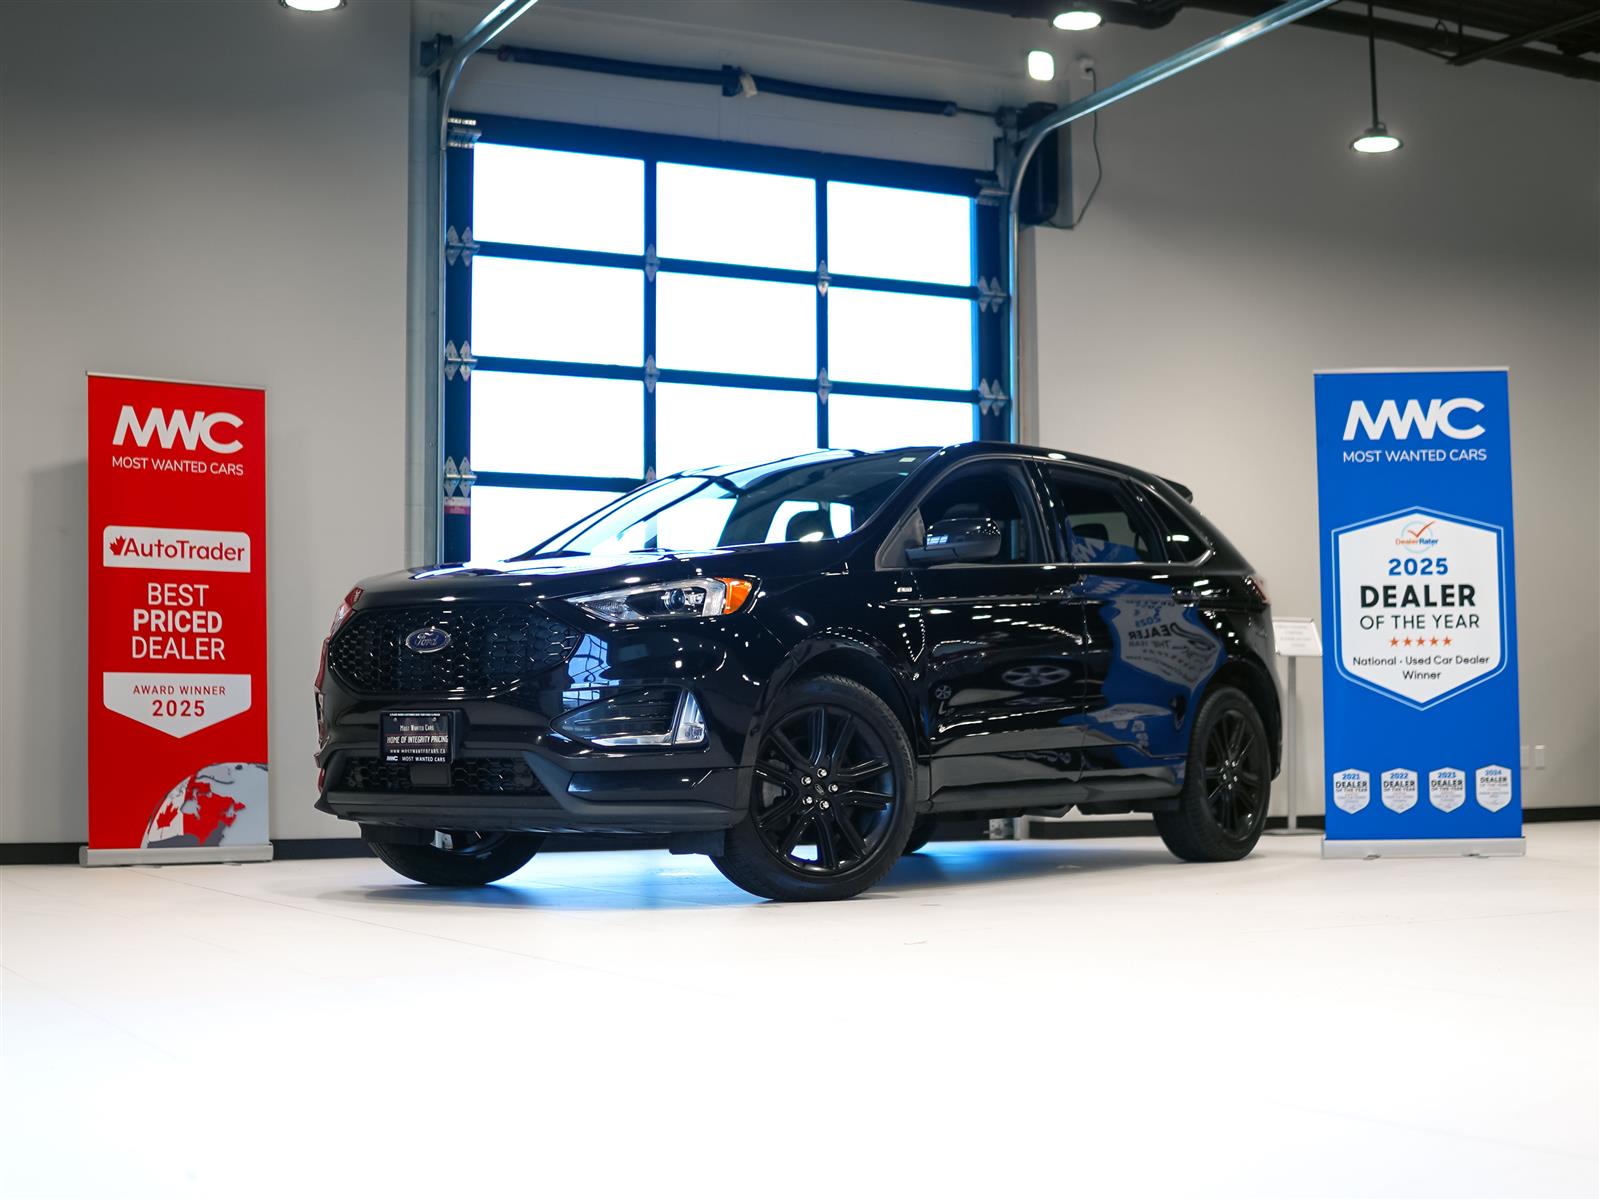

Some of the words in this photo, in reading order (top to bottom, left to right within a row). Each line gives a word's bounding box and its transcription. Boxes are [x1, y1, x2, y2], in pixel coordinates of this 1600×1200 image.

[1342, 397, 1486, 441] MWC
[112, 404, 244, 454] MWC
[1343, 450, 1382, 463] MOST
[1385, 449, 1447, 462] WANTED
[1449, 449, 1488, 461] CARS
[112, 455, 149, 470] MOST
[151, 458, 207, 474] WANTED
[210, 462, 244, 476] CARS
[123, 537, 245, 561] AutoTrader
[1388, 557, 1449, 576] 2025
[147, 582, 210, 607] BEST
[1360, 583, 1477, 609] DEALER
[132, 608, 224, 634] PRICED
[1359, 615, 1385, 630] OF
[1391, 614, 1426, 630] THE
[1432, 613, 1480, 629] YEAR
[416, 631, 439, 647] Ford
[131, 636, 226, 661] DEALER
[1353, 656, 1397, 666] National
[1405, 655, 1431, 666] Used
[1433, 655, 1453, 665] Car
[1455, 654, 1490, 665] Dealer
[1402, 669, 1442, 680] Winner
[132, 684, 175, 696] AWARD
[179, 685, 226, 696] WINNER
[152, 699, 206, 717] 2025
[1335, 780, 1368, 789] DEALER
[1383, 780, 1415, 788] DEALER
[1431, 779, 1463, 787] DEALER
